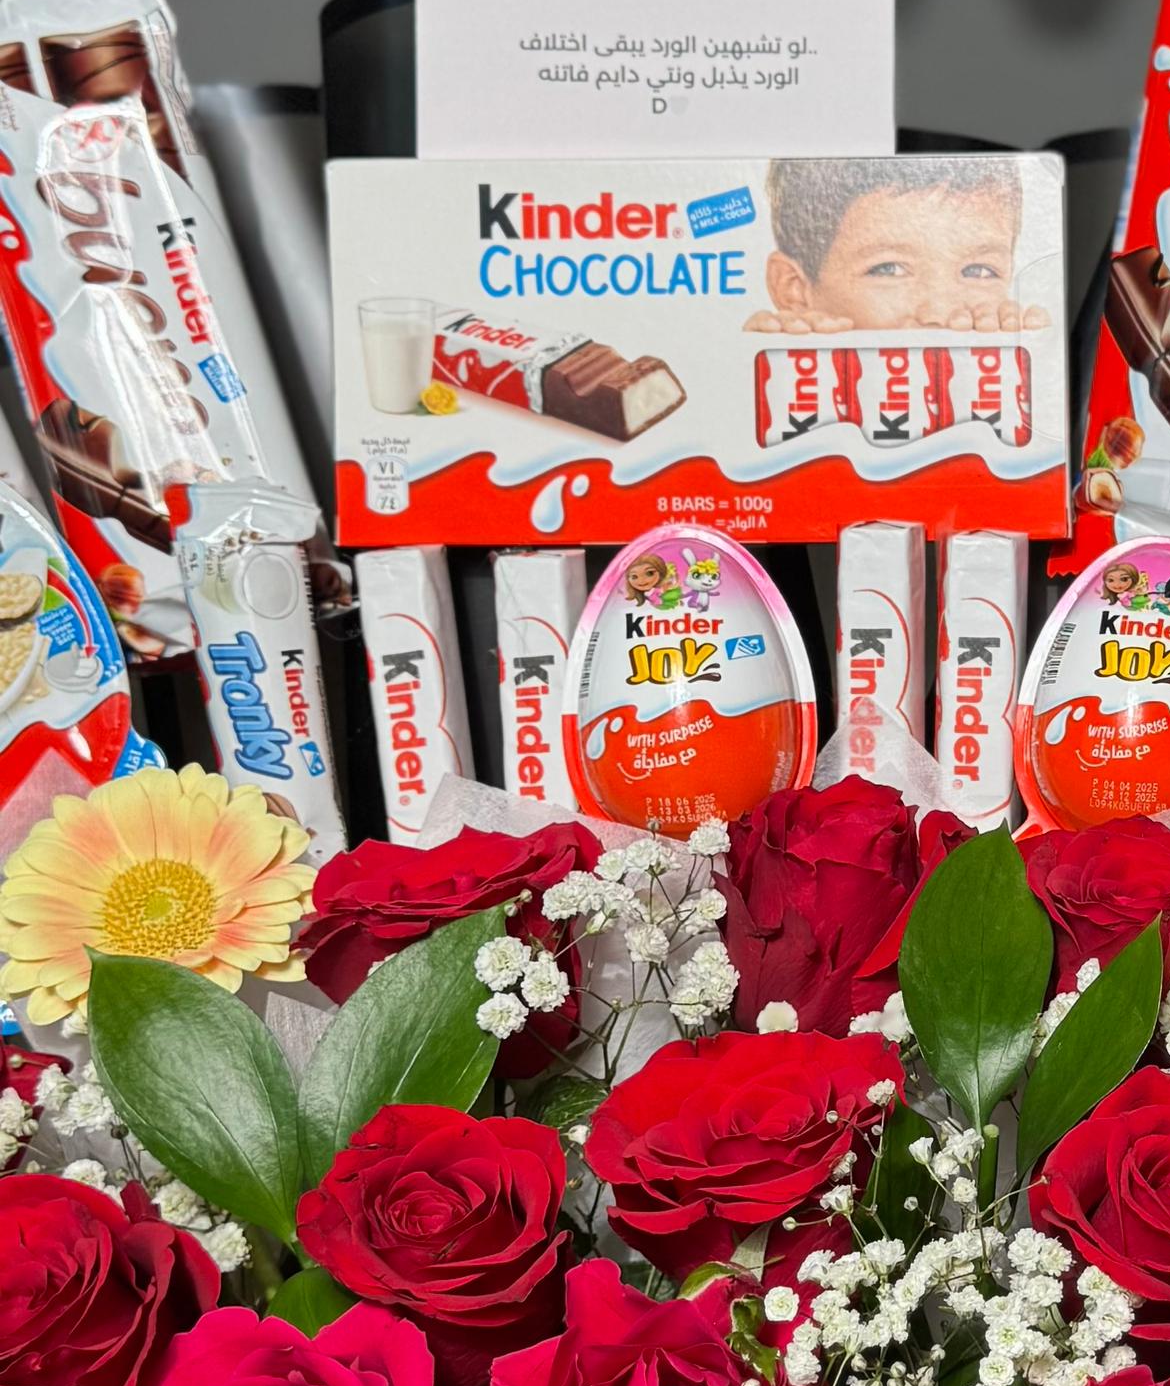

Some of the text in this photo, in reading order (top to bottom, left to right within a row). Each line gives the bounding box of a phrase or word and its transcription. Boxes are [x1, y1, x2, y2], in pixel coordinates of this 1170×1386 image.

[519, 34, 586, 52] اختلاف
[594, 35, 645, 58] يبقى
[651, 36, 696, 58] الورد
[704, 34, 781, 60] تشبهين
[538, 64, 799, 93] الورد يذبل ونتي دايم فاتنه
[652, 98, 667, 114] D
[478, 184, 677, 240] Kinder
[157, 217, 215, 346] Kinder
[443, 313, 537, 348] Kinder
[657, 497, 668, 512] 8
[671, 497, 715, 512] BARS
[733, 497, 773, 513] 100g
[626, 613, 724, 639] Kinder
[626, 637, 718, 685] JOY
[208, 631, 294, 781] Tronky
[281, 649, 311, 738] Kinder
[850, 629, 893, 773] Kinder
[954, 637, 1000, 781] Kinder
[382, 650, 427, 795] Kinder
[513, 655, 555, 801] Kinder
[627, 715, 714, 748] WITH SURPRISE
[1088, 717, 1169, 739] WITH SURPRISE
[633, 747, 697, 770] مع مفاجأة
[1092, 741, 1151, 761] مع مفاجأة
[1092, 778, 1159, 793] P 04 04 2025
[1092, 789, 1157, 803] E 28 12 2025
[646, 797, 652, 806] P
[676, 796, 690, 805] 06
[694, 793, 716, 805] 2025
